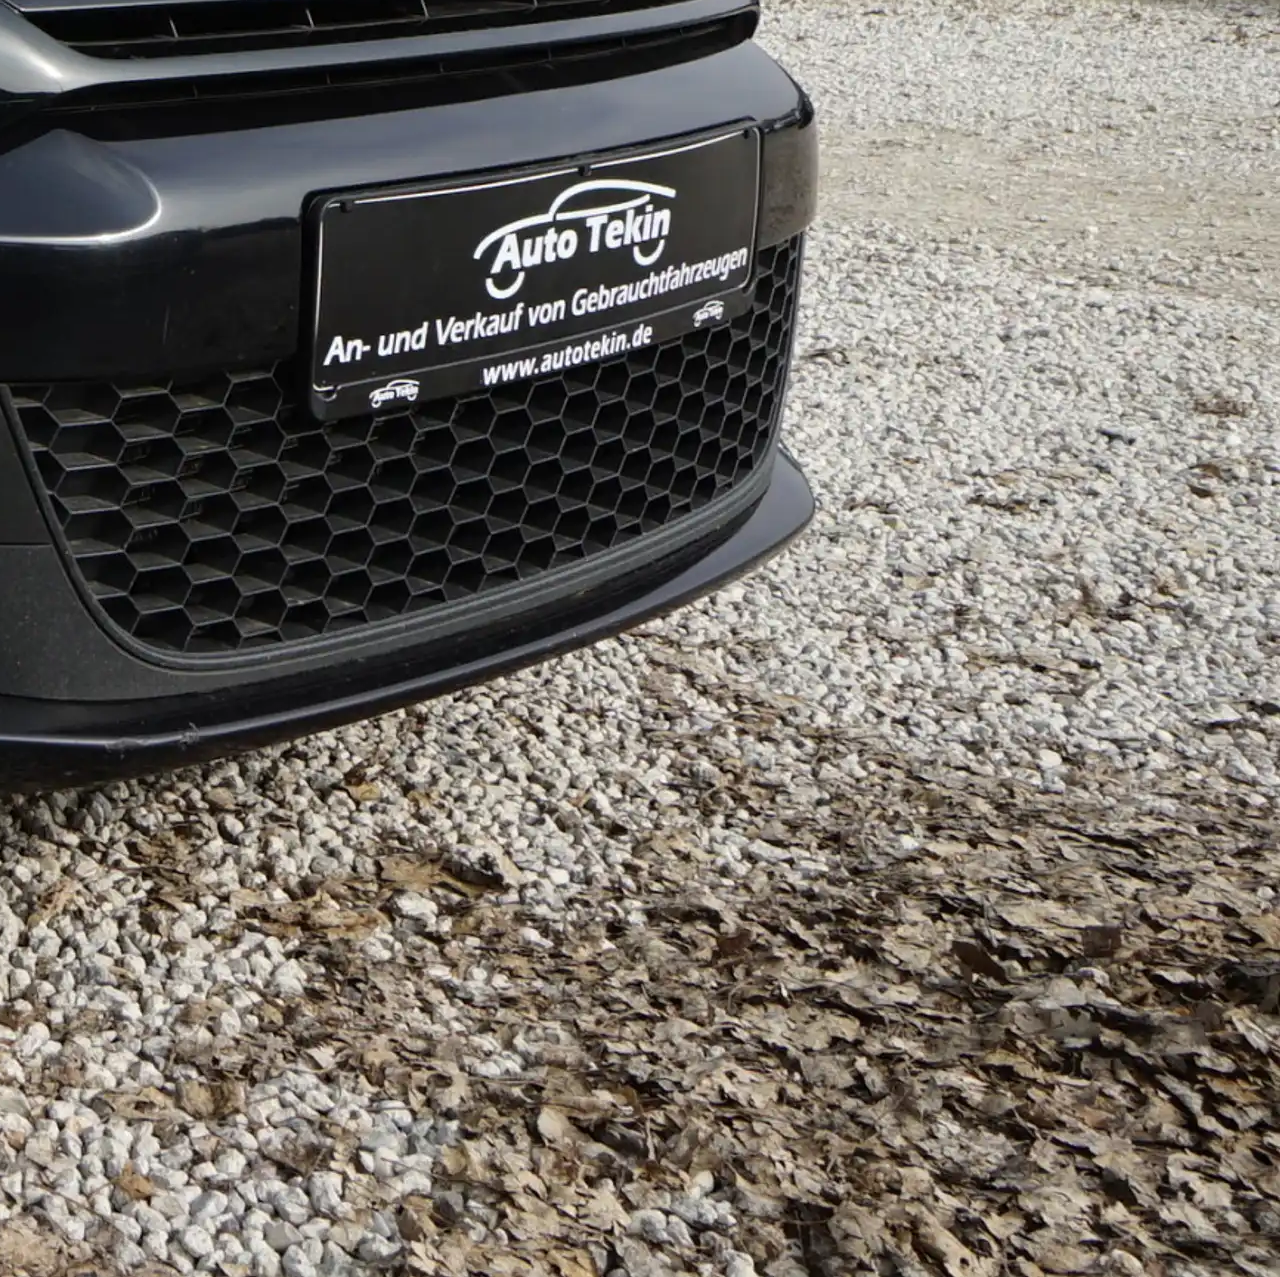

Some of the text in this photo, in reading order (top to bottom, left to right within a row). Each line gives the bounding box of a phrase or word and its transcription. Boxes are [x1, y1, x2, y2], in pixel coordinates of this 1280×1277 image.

[490, 205, 672, 275] Auto Tekin
[323, 333, 371, 367] An-
[377, 321, 429, 357] und
[435, 302, 526, 346] Verkauf
[527, 300, 566, 326] von
[571, 245, 749, 319] Gebrauchtfahrzeugen
[482, 323, 653, 387] www.autotekin.de
